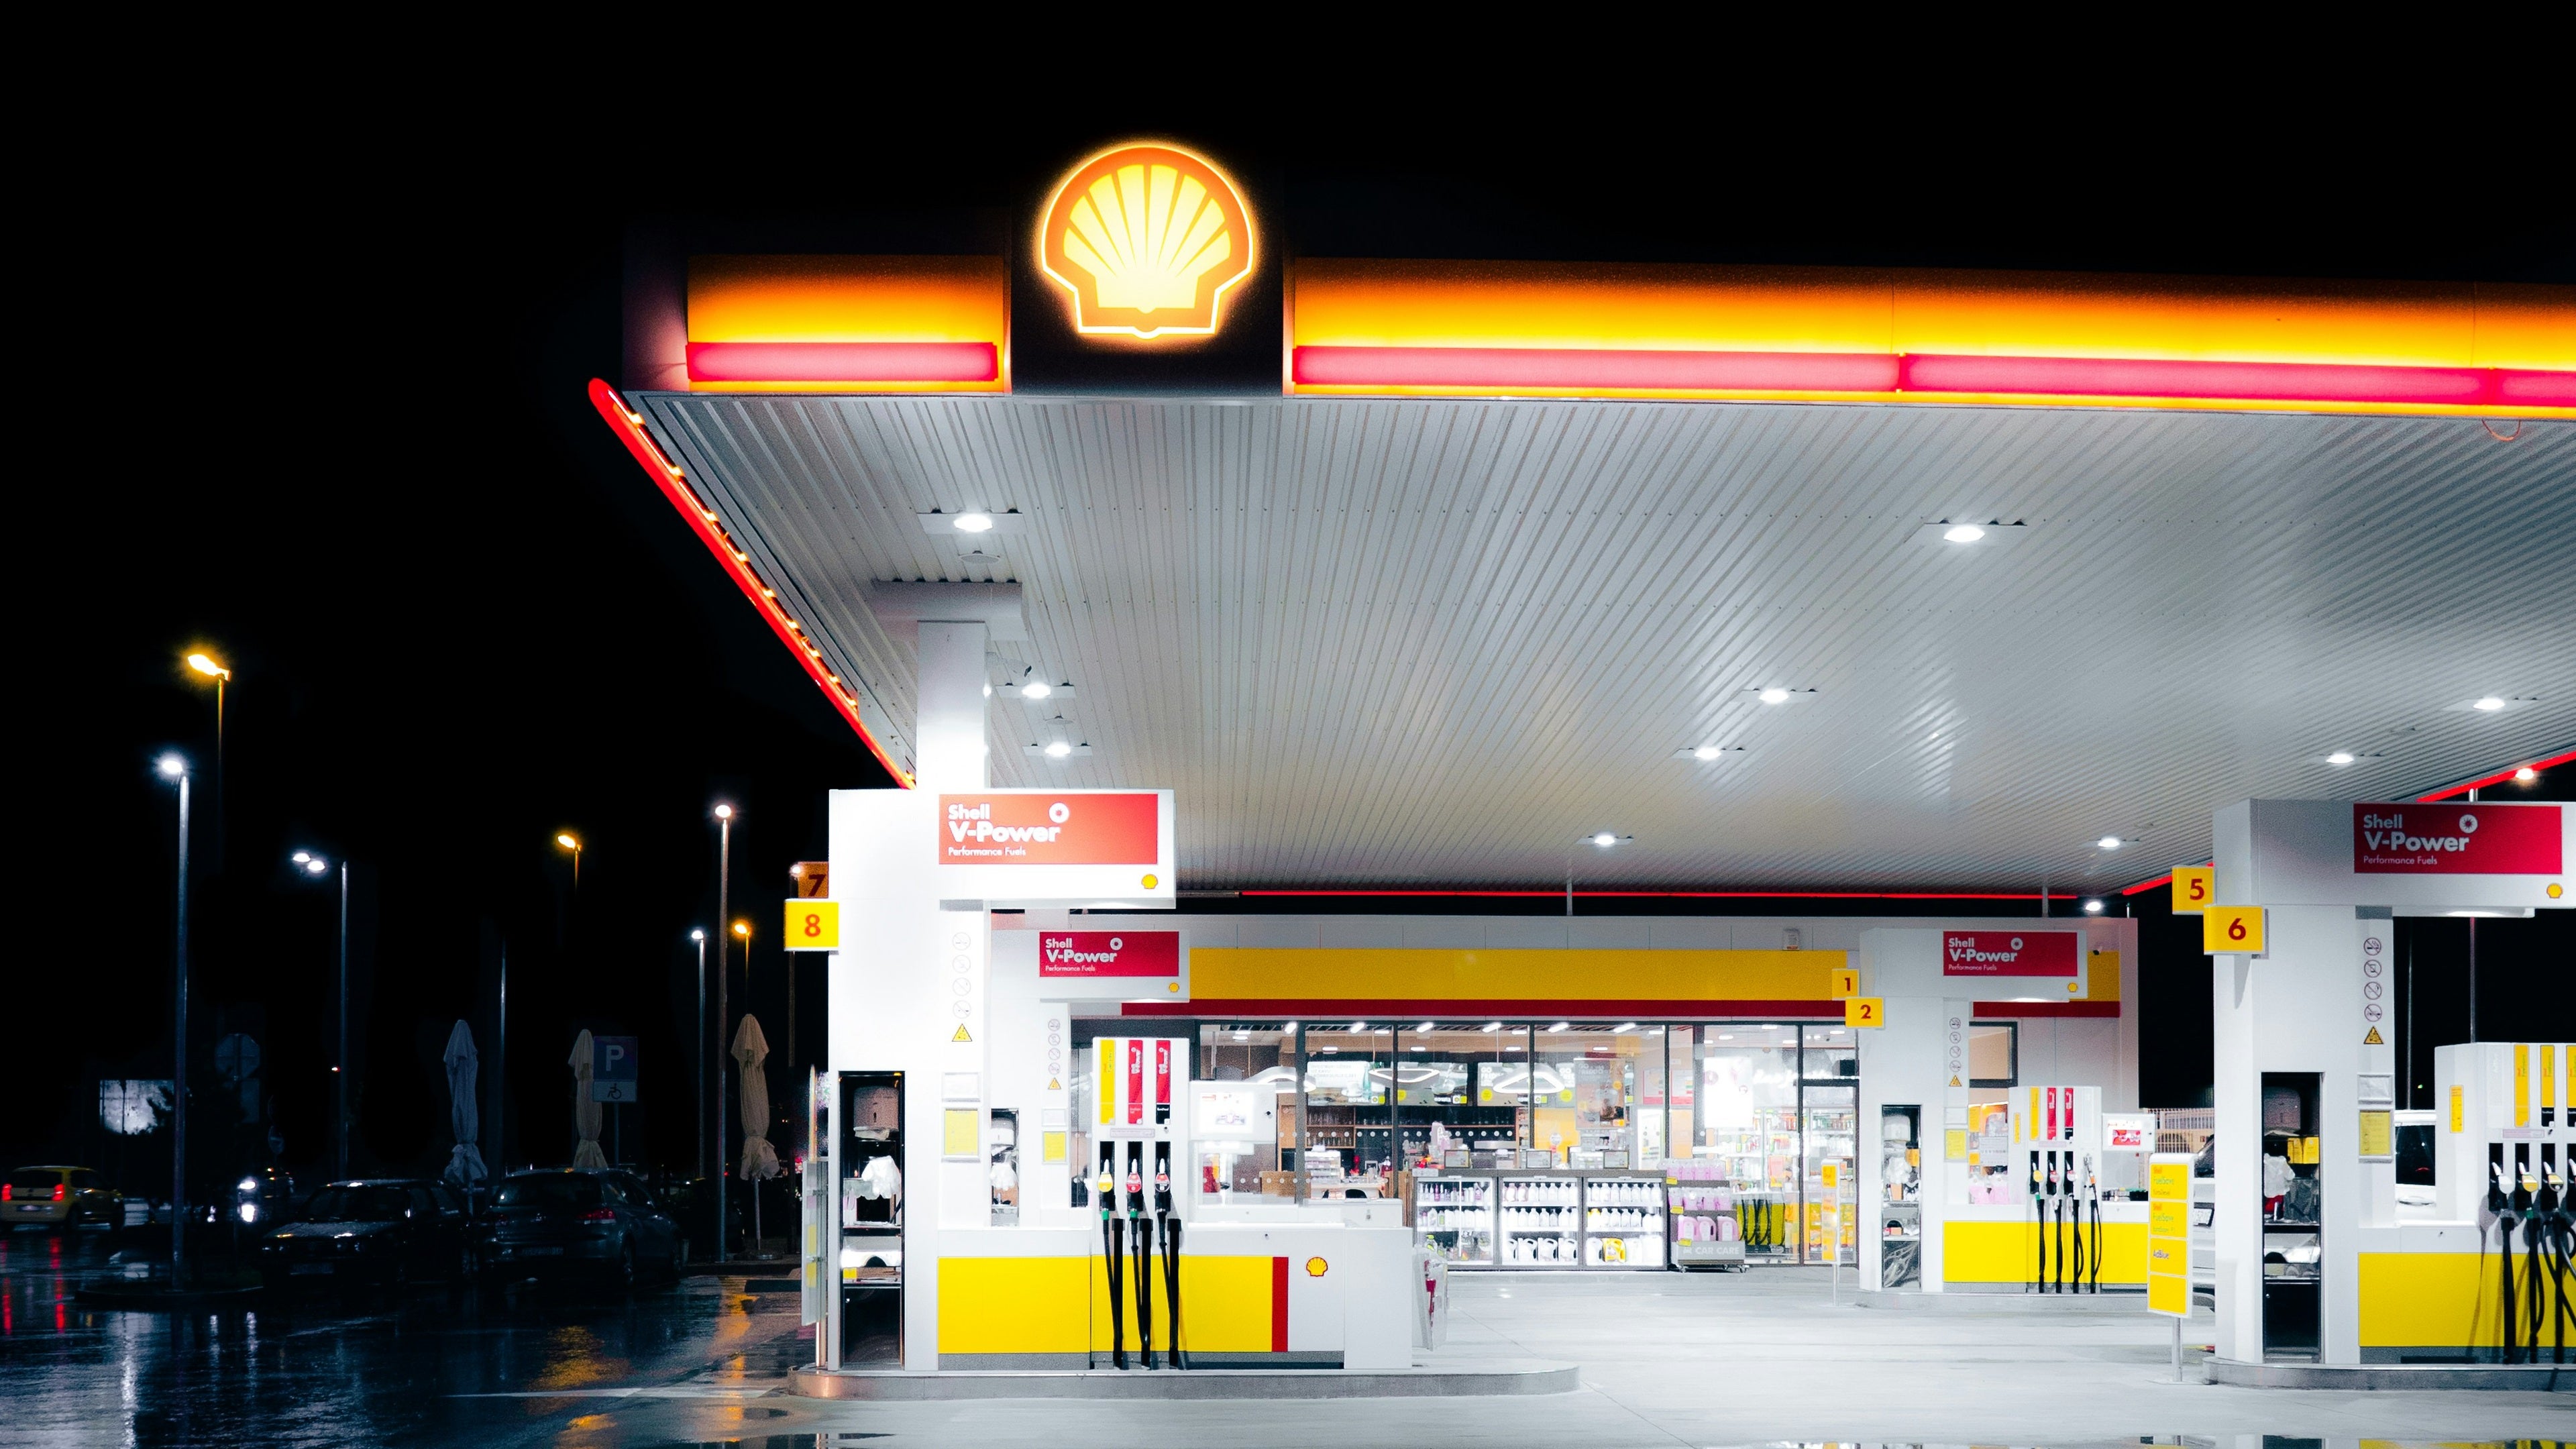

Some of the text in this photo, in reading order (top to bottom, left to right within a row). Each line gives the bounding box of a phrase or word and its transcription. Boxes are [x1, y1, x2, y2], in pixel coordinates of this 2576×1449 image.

[947, 803, 990, 820] Shell
[2363, 813, 2403, 828] Shell
[948, 820, 1061, 843] V-Power
[2364, 830, 2470, 852] V-Power
[947, 845, 1026, 857] Performance Fuels
[2363, 855, 2438, 865] Performance Fuels
[808, 874, 826, 897] 7
[2190, 878, 2205, 900] 5
[804, 914, 821, 937] 8
[2228, 917, 2247, 941] 6
[1045, 937, 1073, 949] Shell
[1948, 937, 1975, 948] Shell
[1045, 949, 1118, 963] V-Power
[1948, 948, 2018, 962] V-Power
[1844, 977, 1851, 991] 1
[1860, 1004, 1872, 1019] 2
[606, 1044, 625, 1071] P
[1695, 1246, 1739, 1254] CAR CARE
